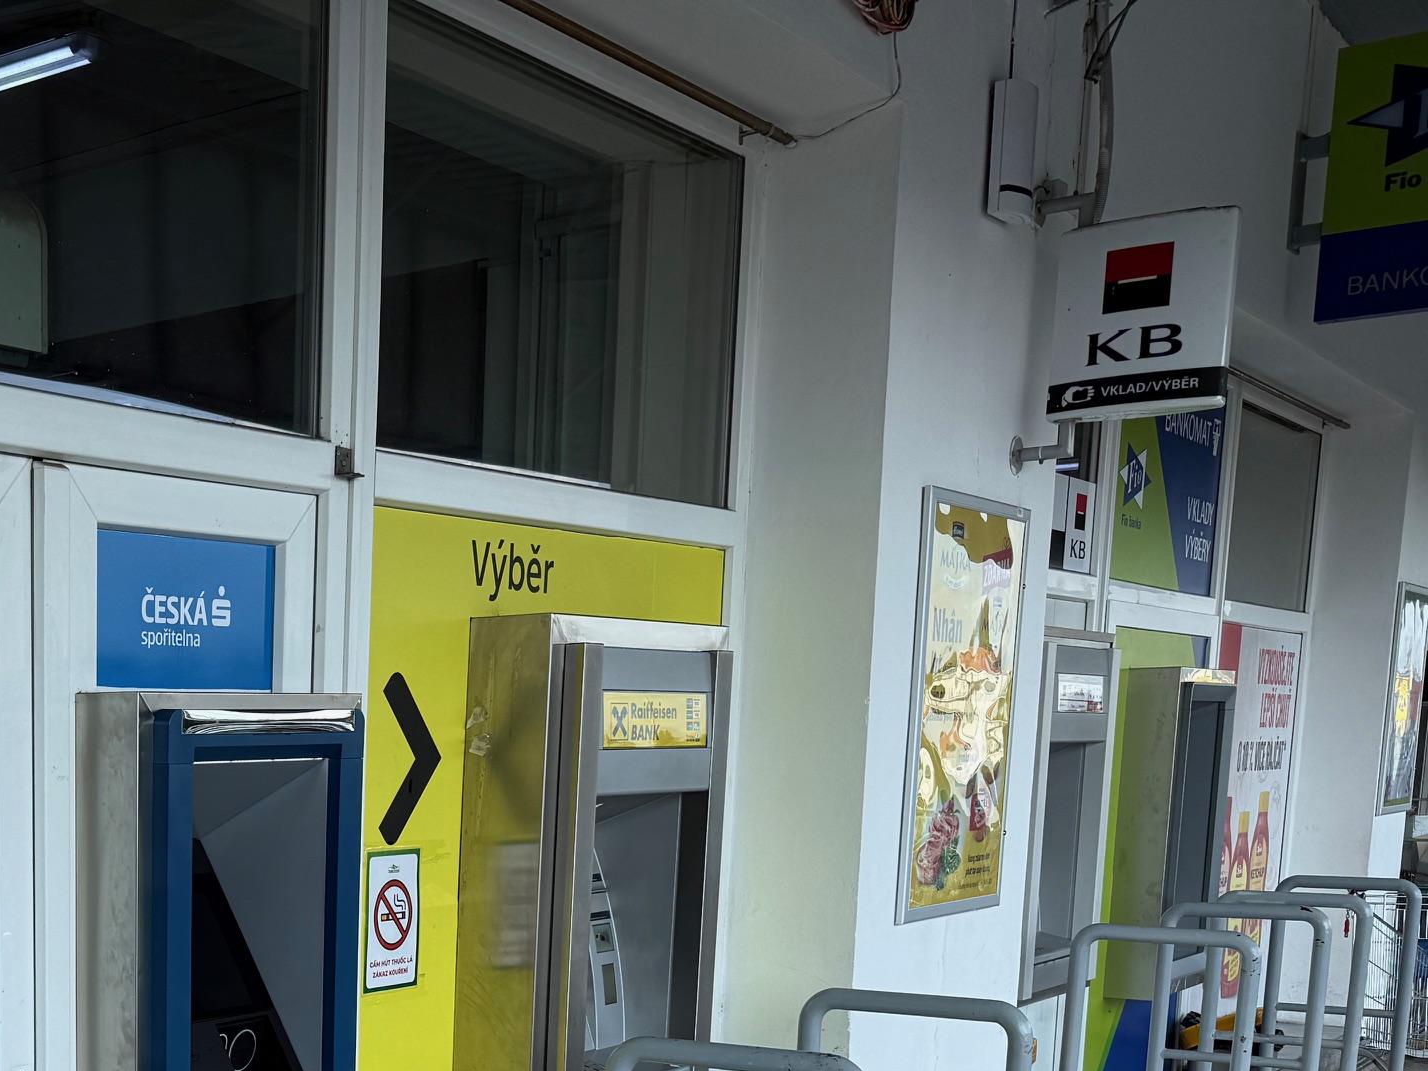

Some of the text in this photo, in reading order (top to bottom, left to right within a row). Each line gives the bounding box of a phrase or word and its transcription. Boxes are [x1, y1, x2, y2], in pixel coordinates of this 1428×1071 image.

[1384, 172, 1422, 192] Fio
[1085, 323, 1184, 367] KB
[1101, 376, 1200, 397] VKLAD/VÝBĚR
[1165, 412, 1213, 447] BANKOMAT
[1127, 459, 1143, 494] Fio
[1187, 496, 1215, 526] VKLADY
[1070, 538, 1086, 560] KB
[1185, 528, 1212, 563] VÝBĚRY
[471, 538, 555, 602] Výběr
[140, 586, 208, 627] ČESKÁ
[140, 628, 201, 649] spořitelna
[630, 701, 678, 721] Raiffeisen
[630, 724, 660, 741] BANK
